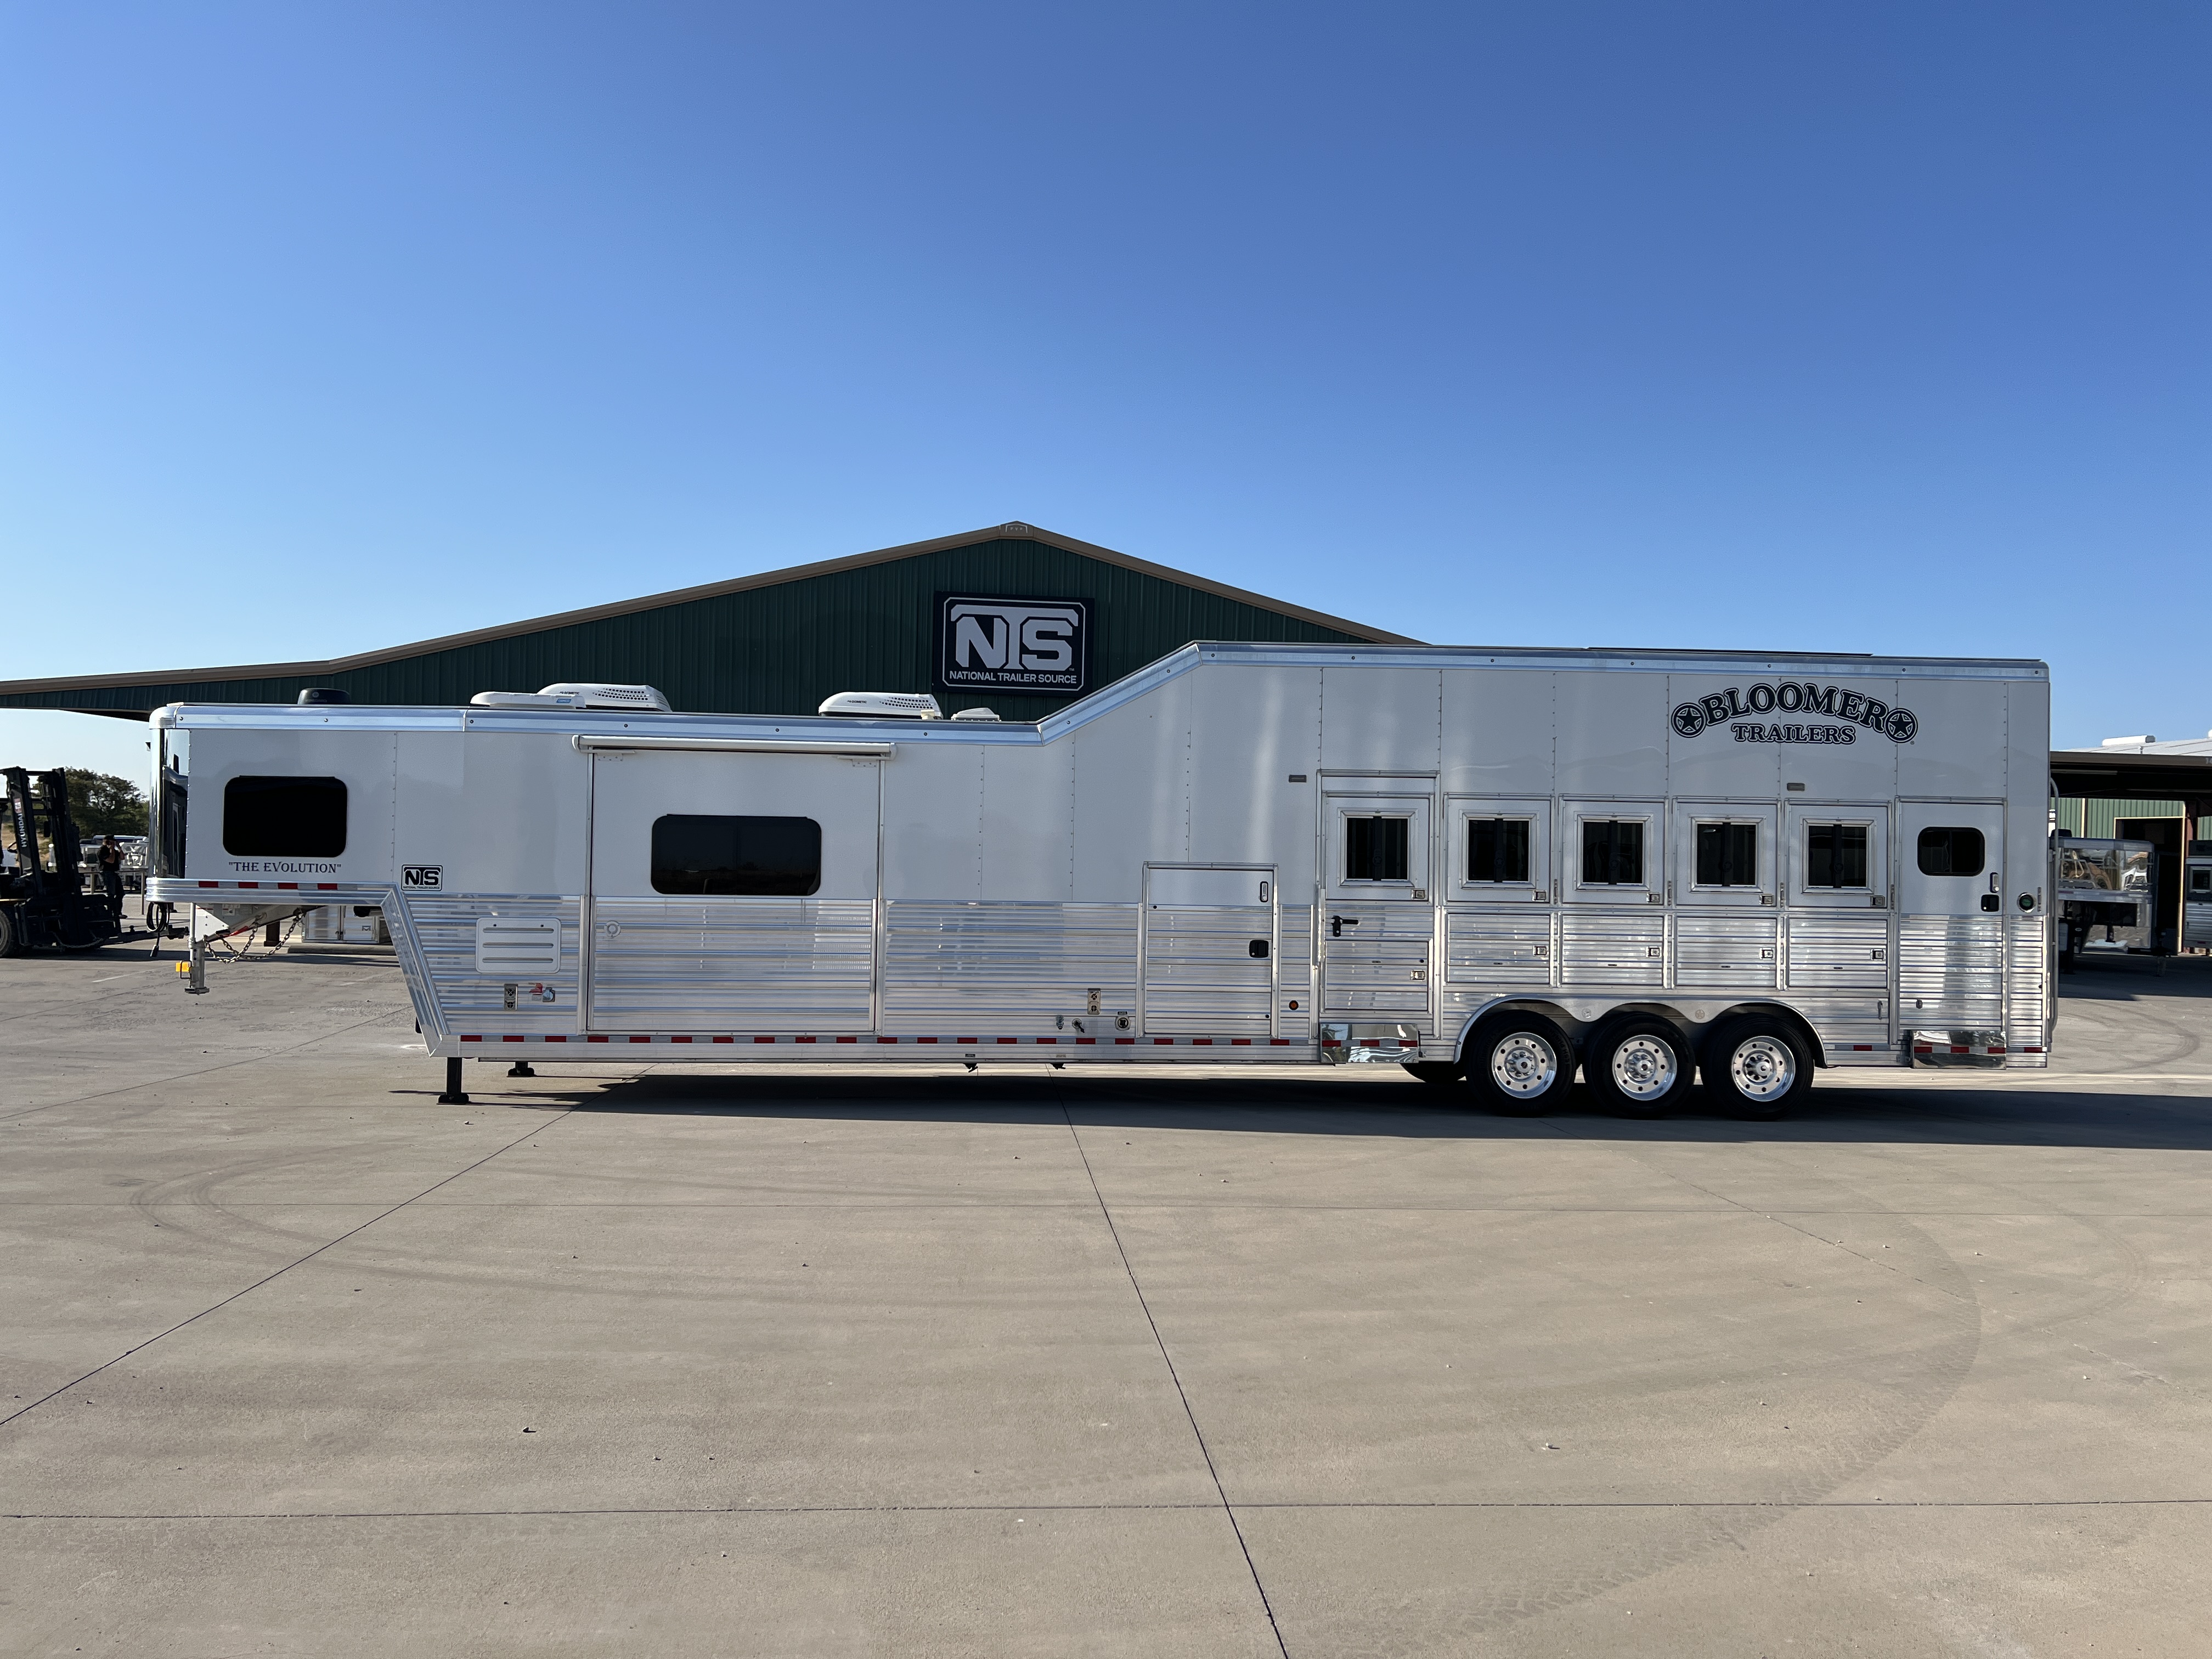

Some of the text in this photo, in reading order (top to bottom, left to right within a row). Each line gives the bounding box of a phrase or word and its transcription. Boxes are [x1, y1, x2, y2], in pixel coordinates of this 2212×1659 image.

[951, 604, 1079, 671] NTS
[950, 670, 1077, 684] NATIONAL TRAILER SOURCE
[1699, 681, 1891, 733] BLOOMER
[1731, 723, 1856, 744] TRAILERS
[18, 813, 27, 848] HYUNDAI
[229, 861, 341, 873] "THE EVOLUTION"
[404, 867, 441, 885] NTS
